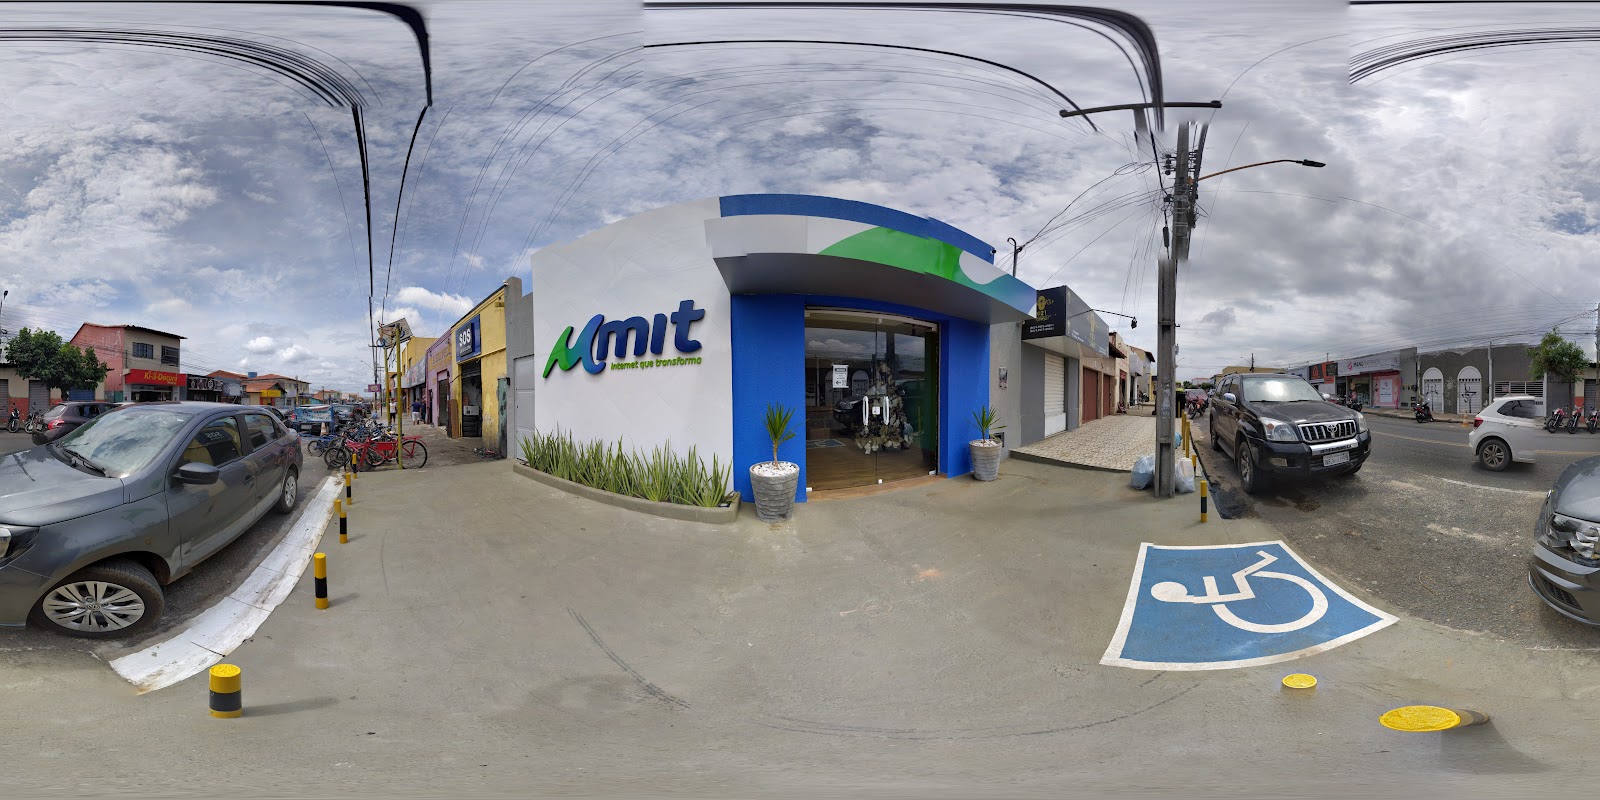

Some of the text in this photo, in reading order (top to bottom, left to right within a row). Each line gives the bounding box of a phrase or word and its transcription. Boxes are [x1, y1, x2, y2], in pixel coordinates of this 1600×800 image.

[459, 328, 471, 347] SOS
[640, 359, 654, 369] que
[655, 356, 703, 367] transforma
